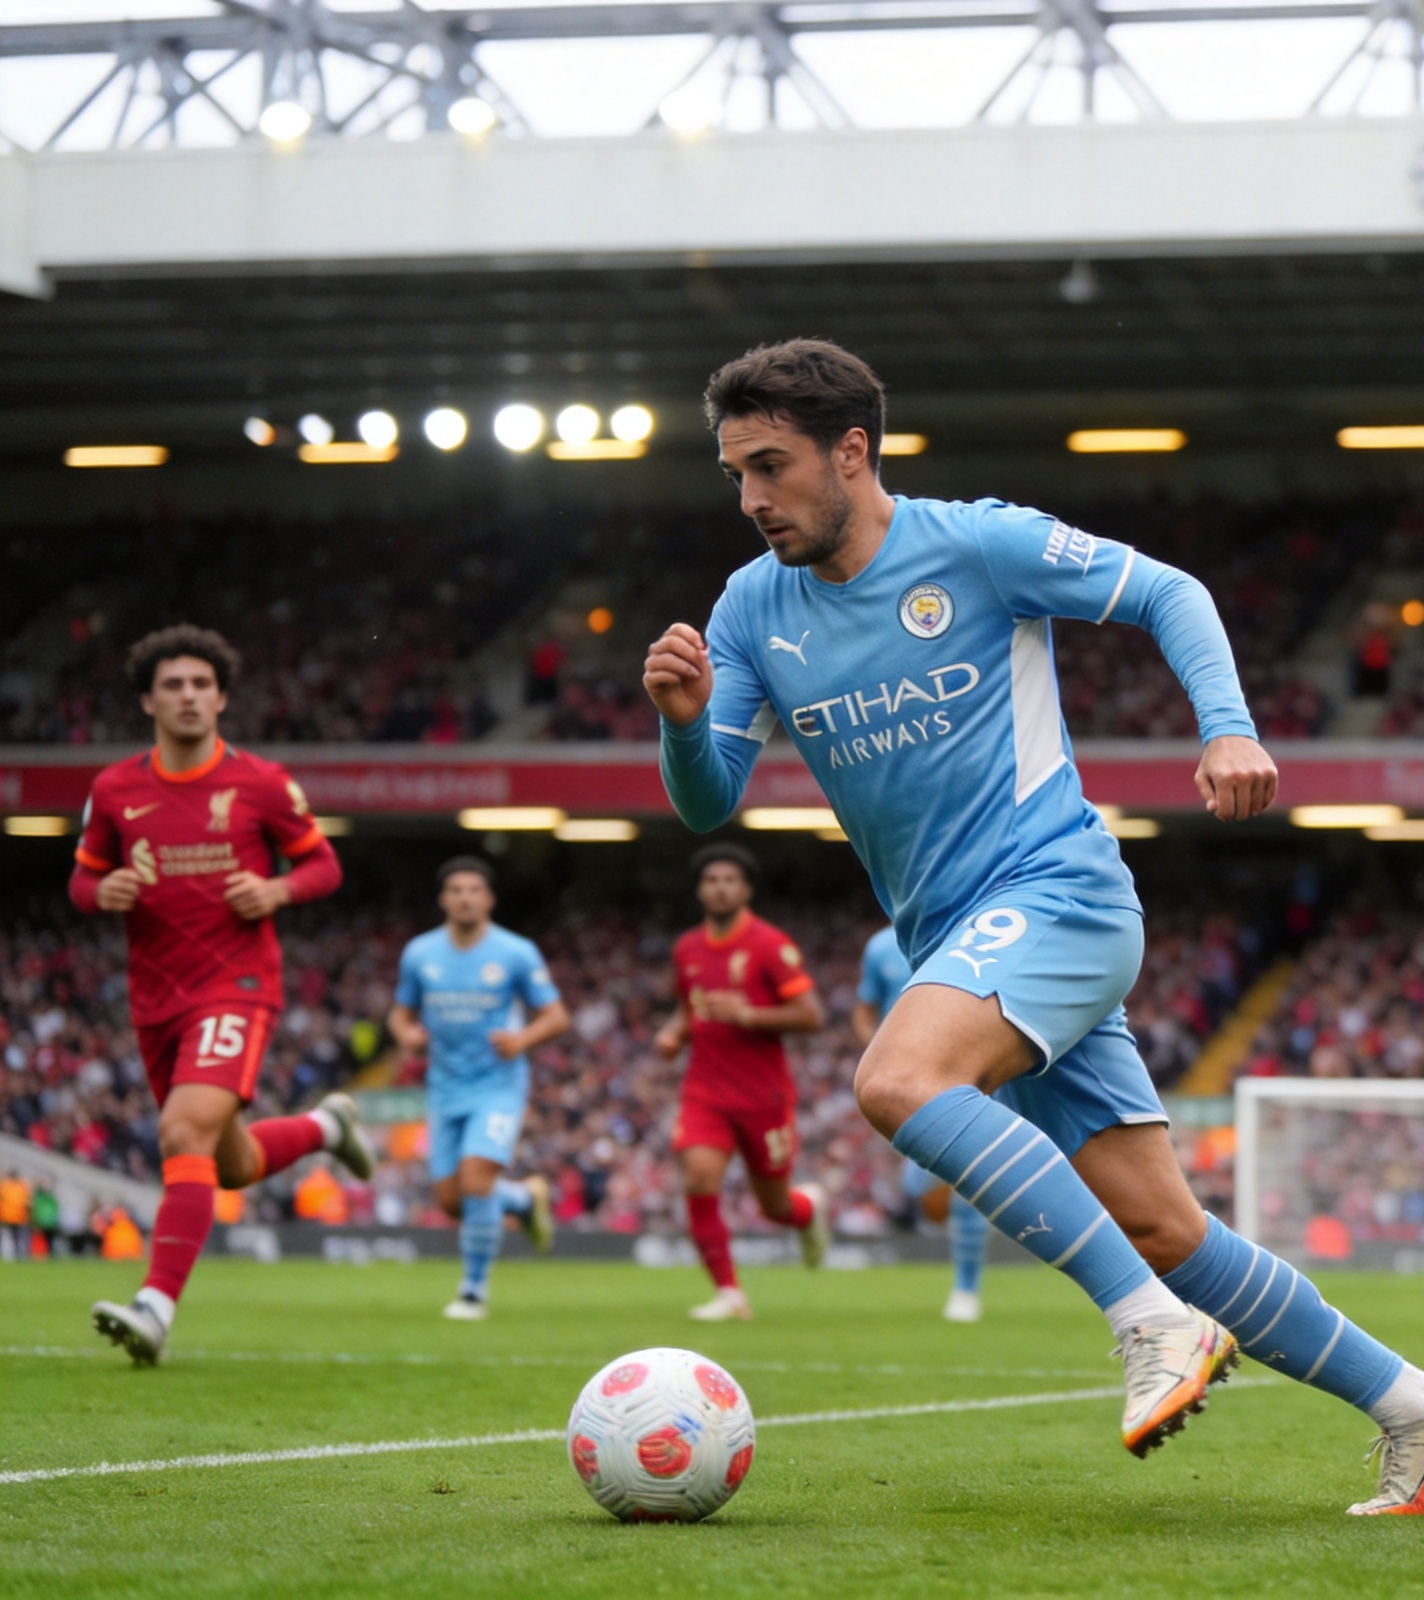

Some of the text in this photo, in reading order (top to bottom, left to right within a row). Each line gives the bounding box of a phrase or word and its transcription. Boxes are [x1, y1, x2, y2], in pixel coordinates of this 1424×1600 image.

[792, 662, 980, 737] ETIHAD
[829, 710, 952, 769] AIRWAYS
[198, 1013, 247, 1057] 15
